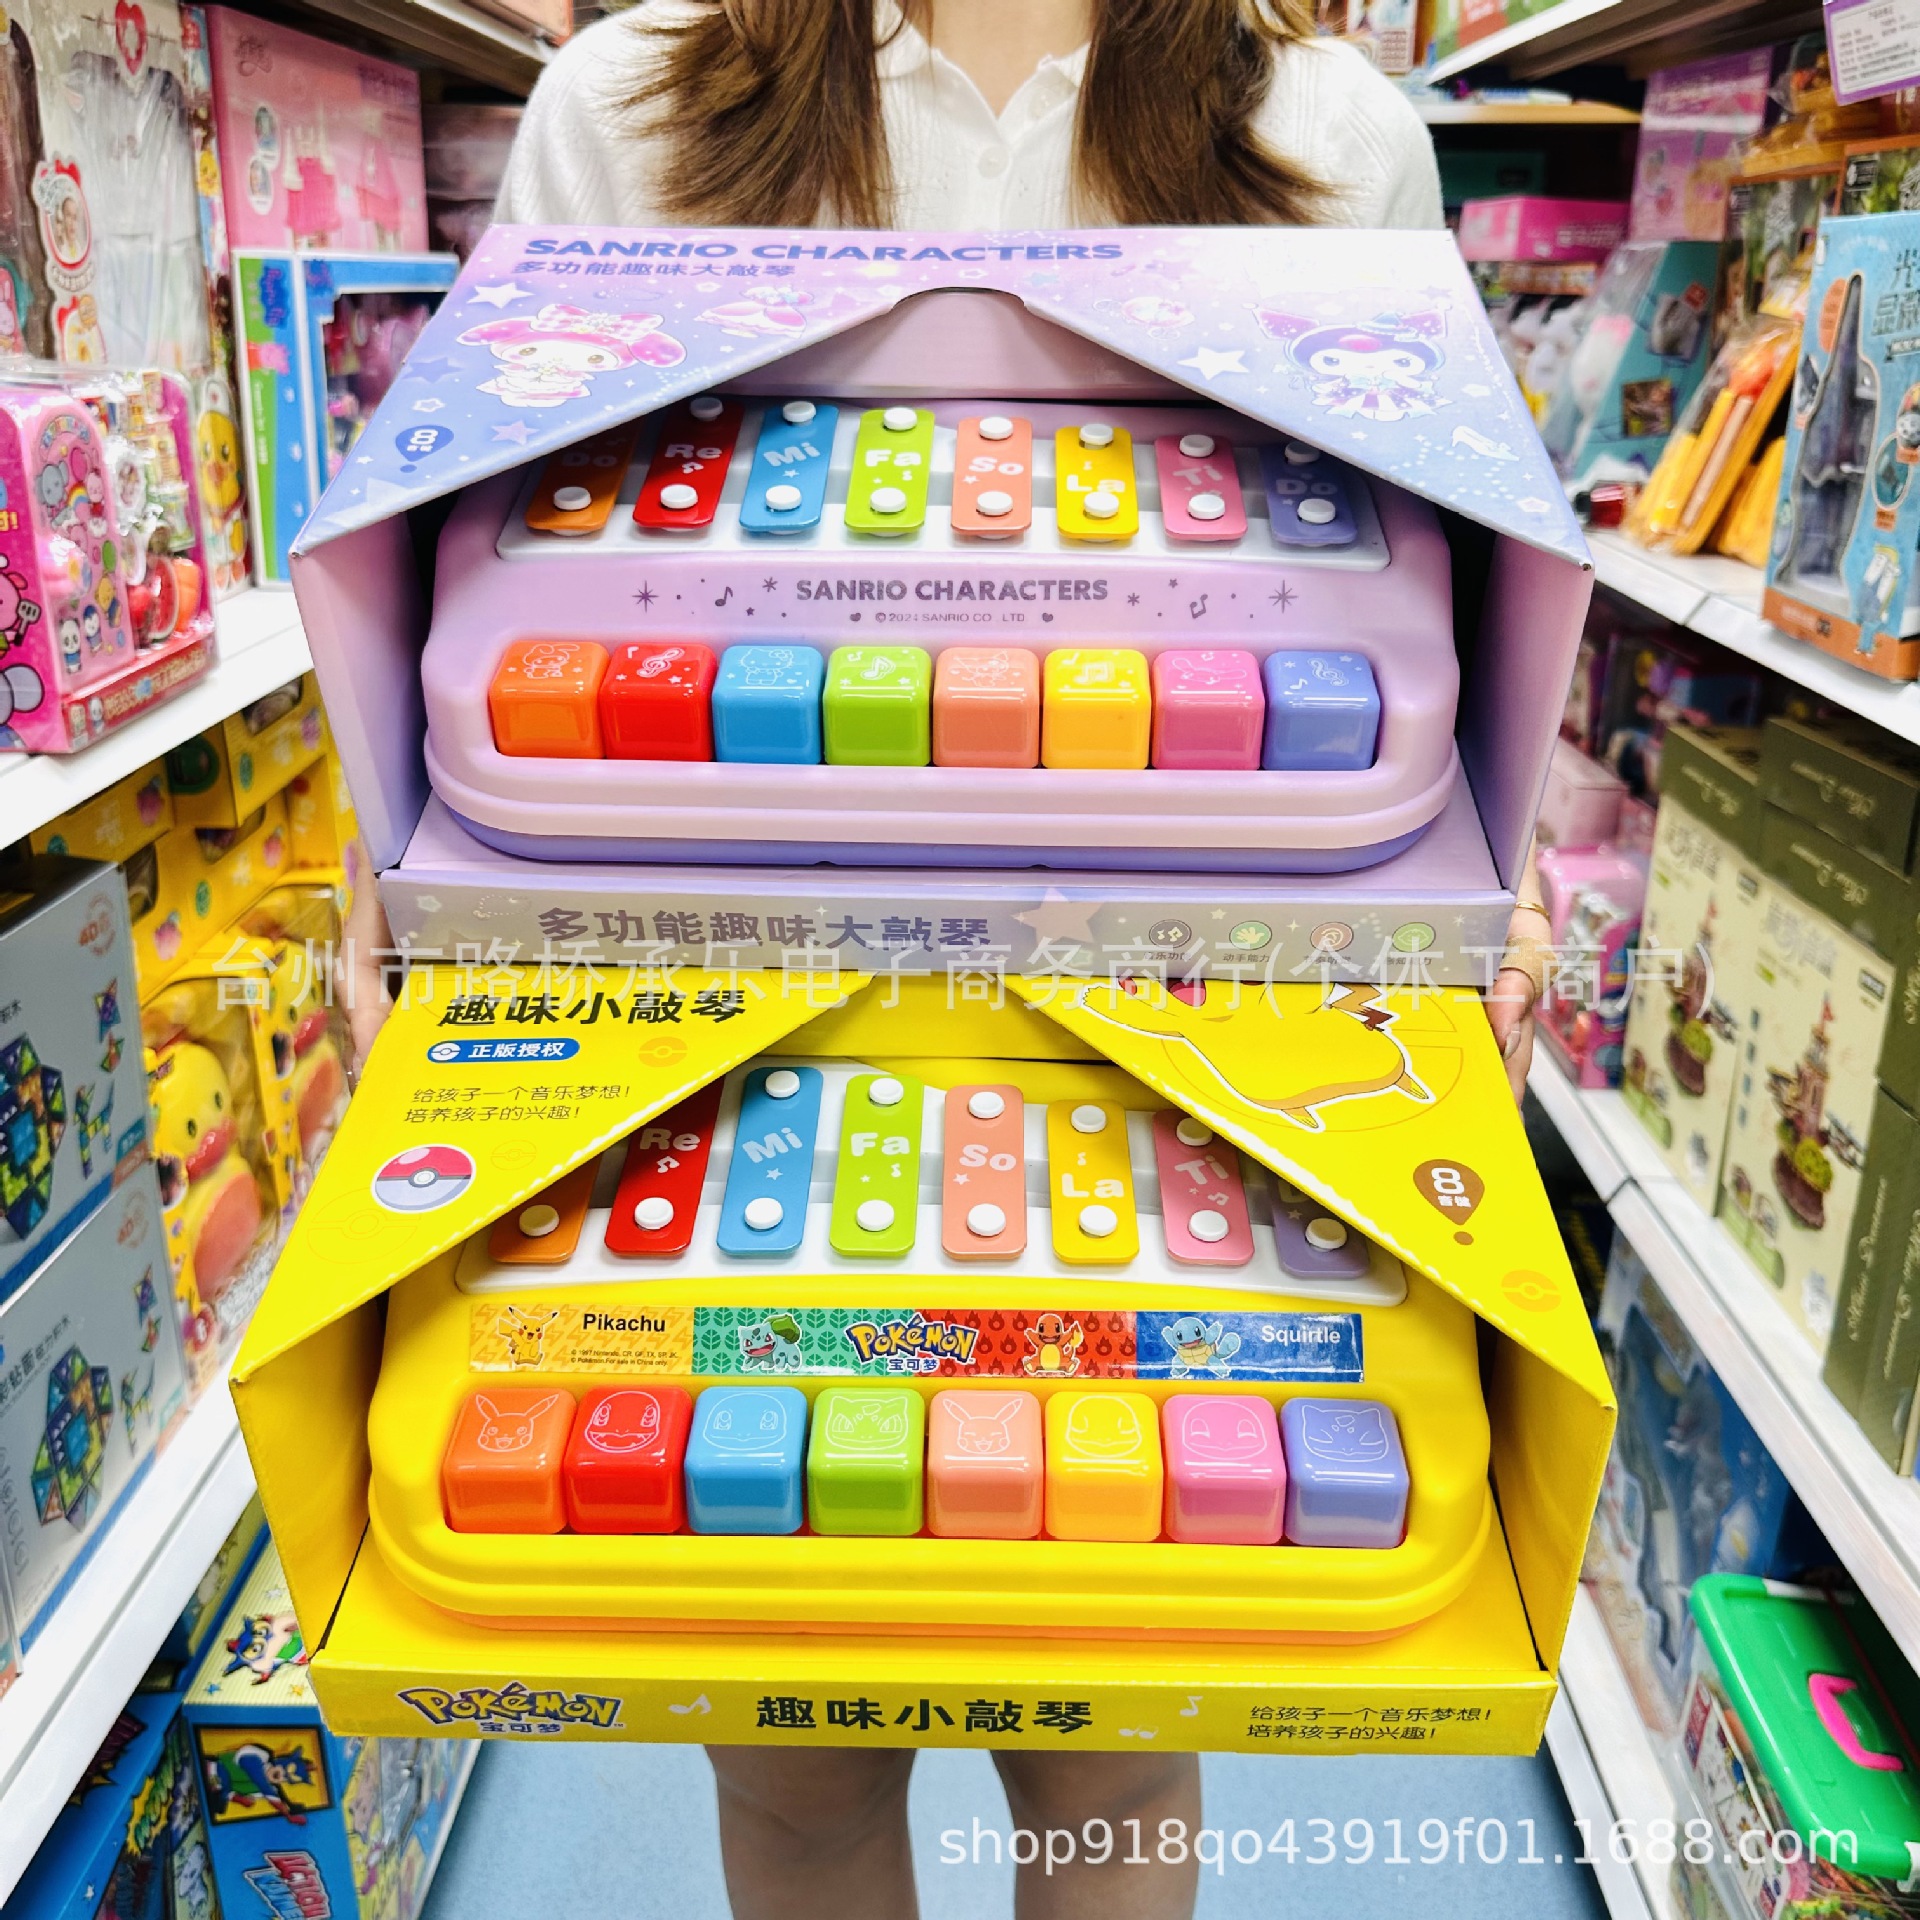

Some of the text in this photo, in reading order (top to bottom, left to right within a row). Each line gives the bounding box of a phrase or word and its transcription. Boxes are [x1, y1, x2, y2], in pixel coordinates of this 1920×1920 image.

[526, 239, 1123, 261] SANRIO CHARACTERS
[511, 261, 795, 277] 多功能趣味大敲琴
[410, 428, 438, 445] 8
[561, 451, 618, 468] Do
[665, 443, 722, 460] Re
[763, 442, 821, 467] Mi
[865, 449, 922, 468] Fa
[969, 456, 1024, 476] So
[1173, 464, 1224, 486] Ti
[1066, 474, 1126, 493] La
[1276, 478, 1337, 496] Do
[796, 580, 1108, 601] SANRIO CHARACTERS
[922, 613, 969, 622] SANRIO
[537, 906, 991, 953] 多功能趣味大敲琴
[437, 991, 746, 1027] 趣味小敲琴
[468, 1041, 567, 1058] 正版授权
[413, 1085, 630, 1104] 给孩子一个音乐梦想！
[404, 1105, 580, 1123] 培养孩子的兴趣！
[639, 1128, 701, 1152] Re
[742, 1127, 803, 1164] Mi
[851, 1132, 910, 1157] Fa
[959, 1144, 1017, 1171] So
[1175, 1155, 1229, 1185] Ti
[1061, 1173, 1125, 1198] La
[1431, 1167, 1465, 1195] 8
[583, 1313, 666, 1333] Pikachu
[1261, 1324, 1341, 1345] Squirtle
[888, 1357, 939, 1372] 宝可梦
[756, 1695, 1094, 1734] 趣味小敲琴
[1250, 1706, 1492, 1722] 给孩子一个音乐梦想！
[480, 1721, 563, 1734] 宝可梦
[1247, 1723, 1437, 1740] 培养孩子的兴趣！
